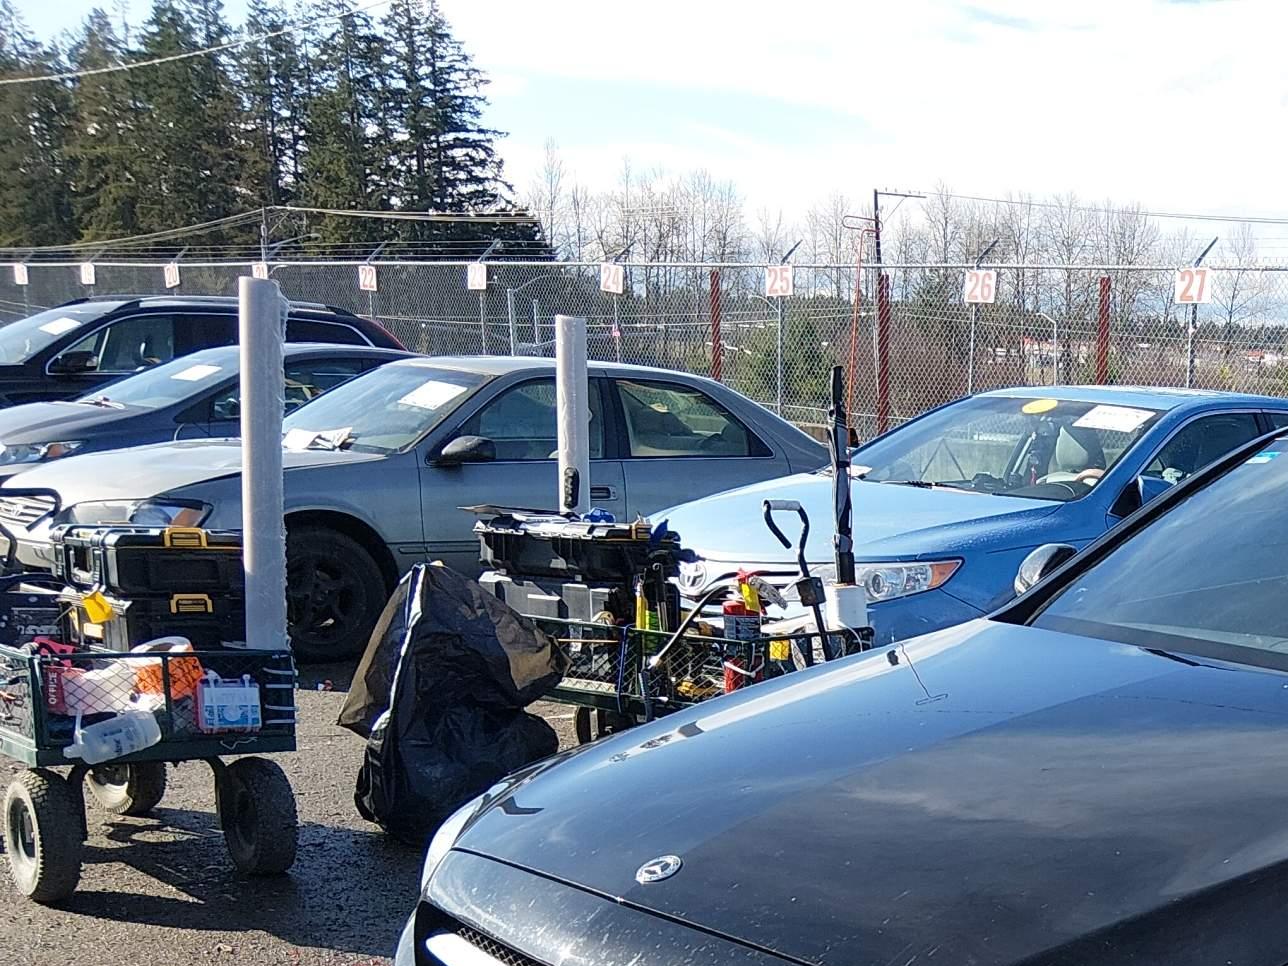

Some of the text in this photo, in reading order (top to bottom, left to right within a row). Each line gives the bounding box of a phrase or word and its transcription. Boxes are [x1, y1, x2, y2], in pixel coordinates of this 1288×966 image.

[166, 265, 178, 285] 20
[361, 268, 375, 289] 22
[470, 265, 484, 287] 23
[603, 266, 621, 291] 24
[768, 267, 790, 294] 25
[967, 271, 992, 300] 26
[1179, 270, 1208, 302] 27
